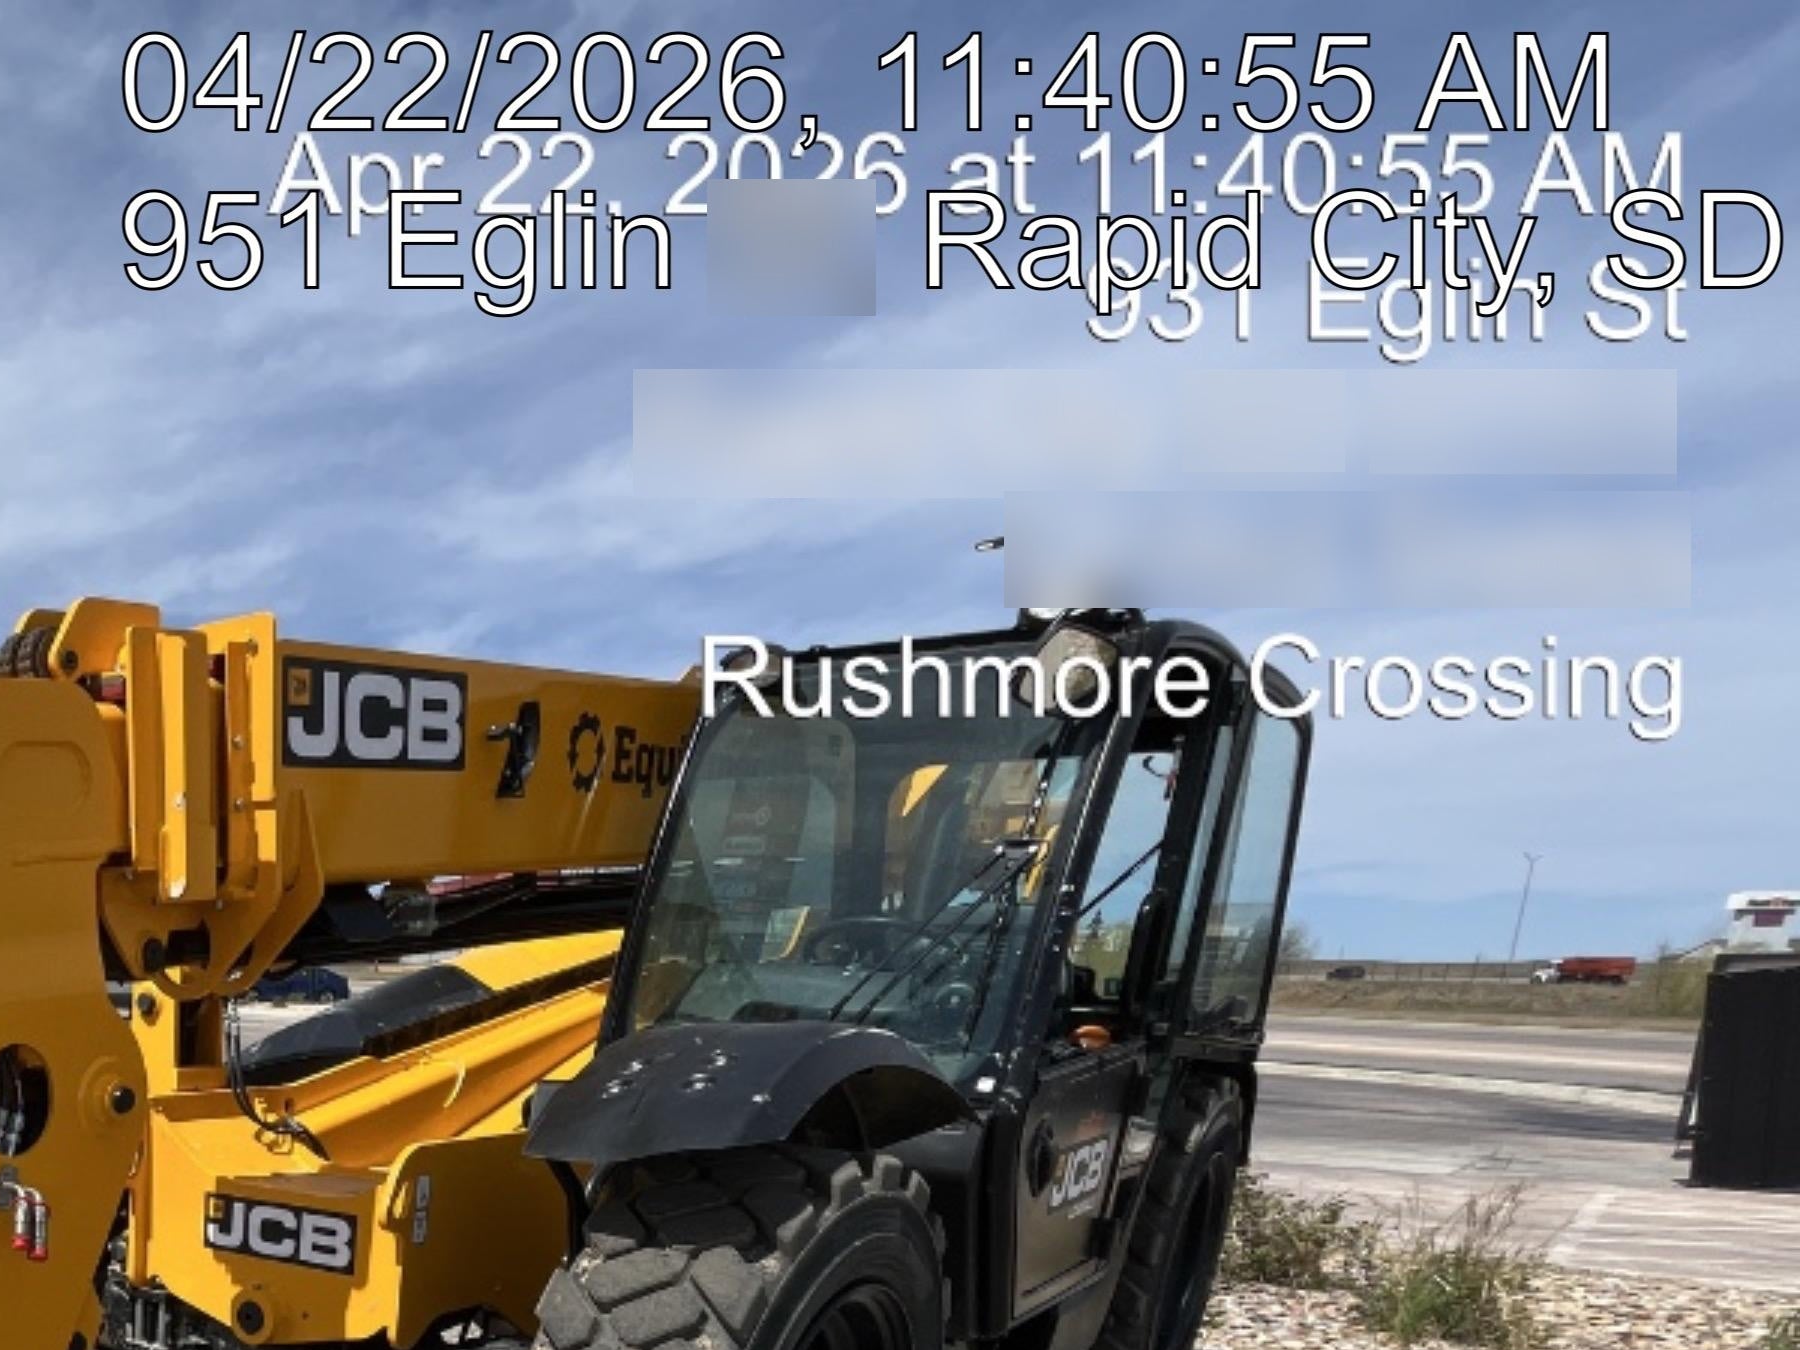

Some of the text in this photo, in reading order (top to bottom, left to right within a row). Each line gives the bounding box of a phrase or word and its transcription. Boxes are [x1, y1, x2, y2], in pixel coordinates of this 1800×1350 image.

[287, 669, 462, 761] JCB
[1049, 1139, 1108, 1207] JCB
[205, 1201, 352, 1268] JCB
